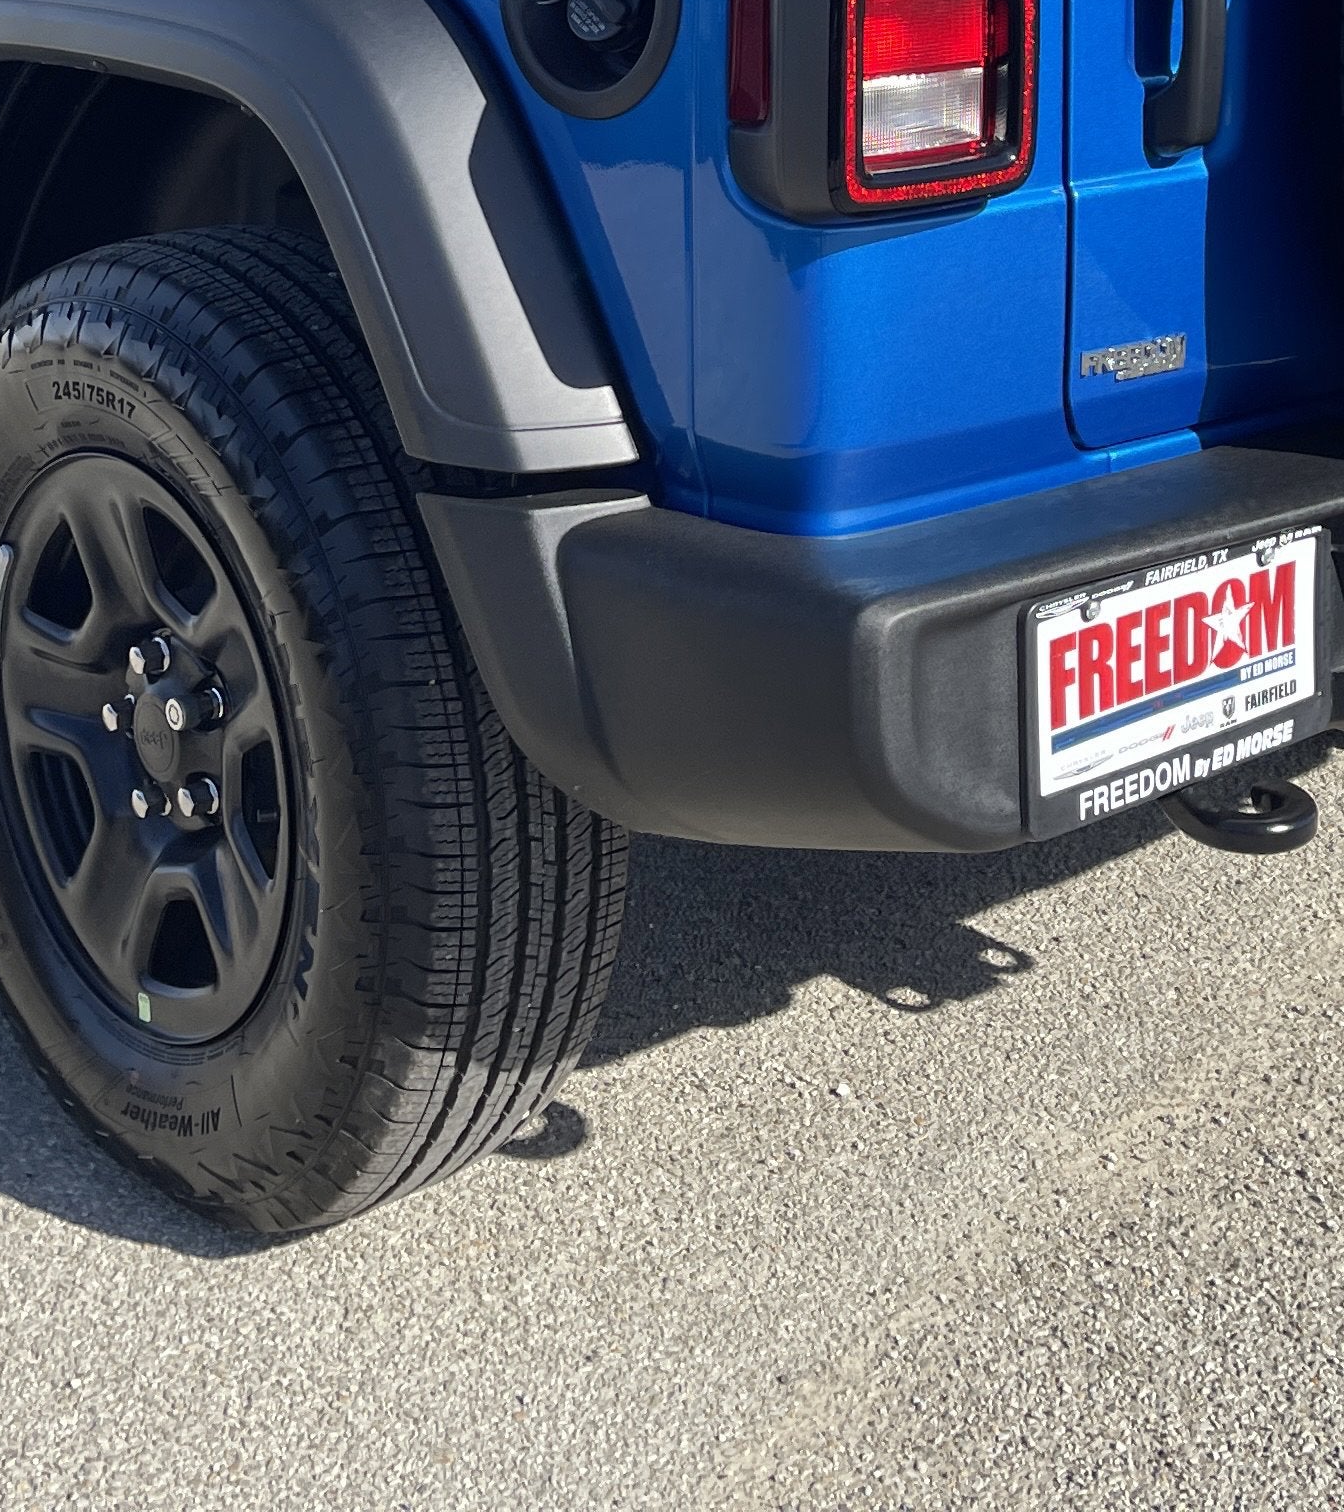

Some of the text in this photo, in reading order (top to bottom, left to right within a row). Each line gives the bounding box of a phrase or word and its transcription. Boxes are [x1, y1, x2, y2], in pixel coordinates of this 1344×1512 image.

[52, 374, 136, 419] 245/75R17
[1211, 548, 1229, 565] TX
[1049, 560, 1296, 732] FREEDOM
[1240, 651, 1294, 681] BY ED MORSE
[1244, 679, 1297, 712] FAIRFIELD
[1180, 710, 1215, 734] Jeep
[1079, 754, 1191, 821] FREEDOM
[1211, 743, 1235, 771] ED
[1236, 719, 1294, 761] MORSE
[120, 1101, 221, 1138] All-Weather
